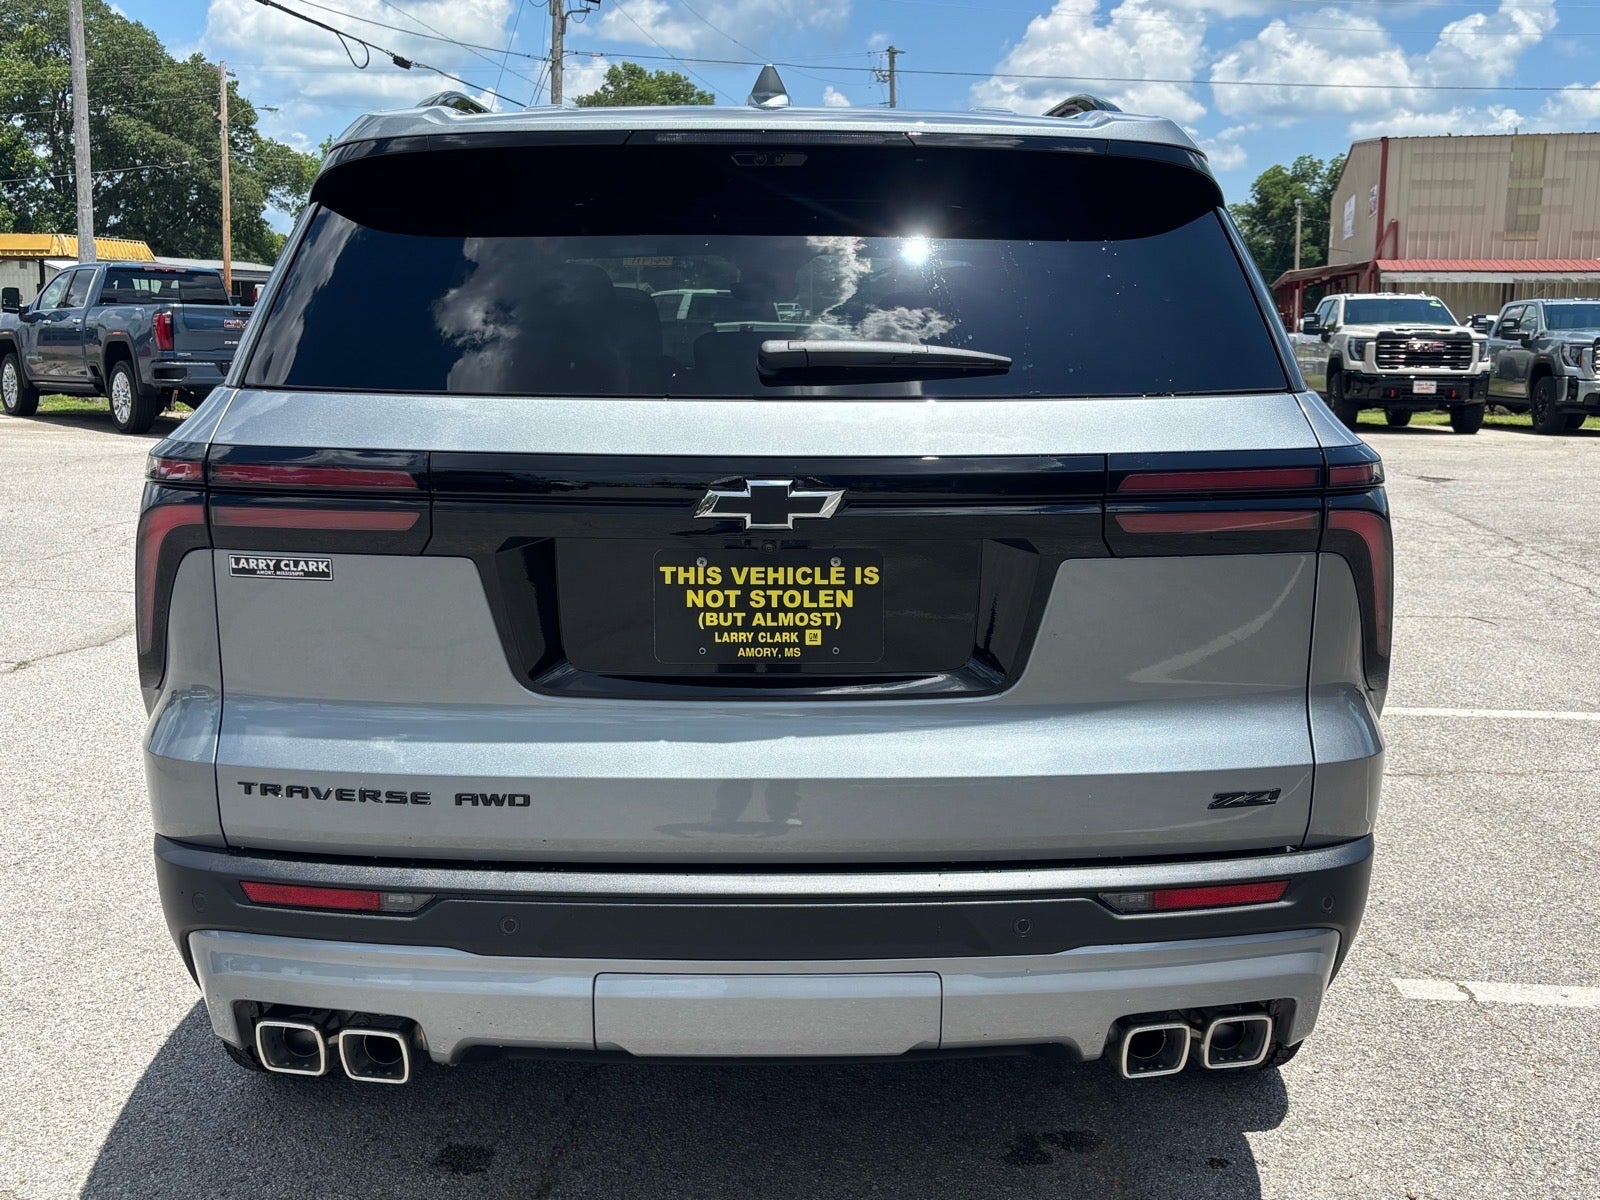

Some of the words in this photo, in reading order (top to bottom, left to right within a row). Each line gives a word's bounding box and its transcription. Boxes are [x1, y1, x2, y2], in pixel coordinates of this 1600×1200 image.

[231, 557, 277, 570] LARRY
[280, 560, 330, 572] CLARK
[659, 566, 723, 585] THIS
[731, 566, 846, 585] VEHICLE
[855, 566, 880, 585] IS
[686, 589, 741, 608] NOT
[750, 589, 854, 608] STOLEN
[698, 611, 746, 629] (BUT
[752, 611, 842, 630] ALMOST)
[714, 632, 755, 643] LARRY
[757, 632, 799, 643] CLARK
[737, 647, 781, 659] AMORY,
[784, 647, 801, 658] MS
[237, 781, 432, 805] TRAVERSE
[455, 792, 531, 807] AWD
